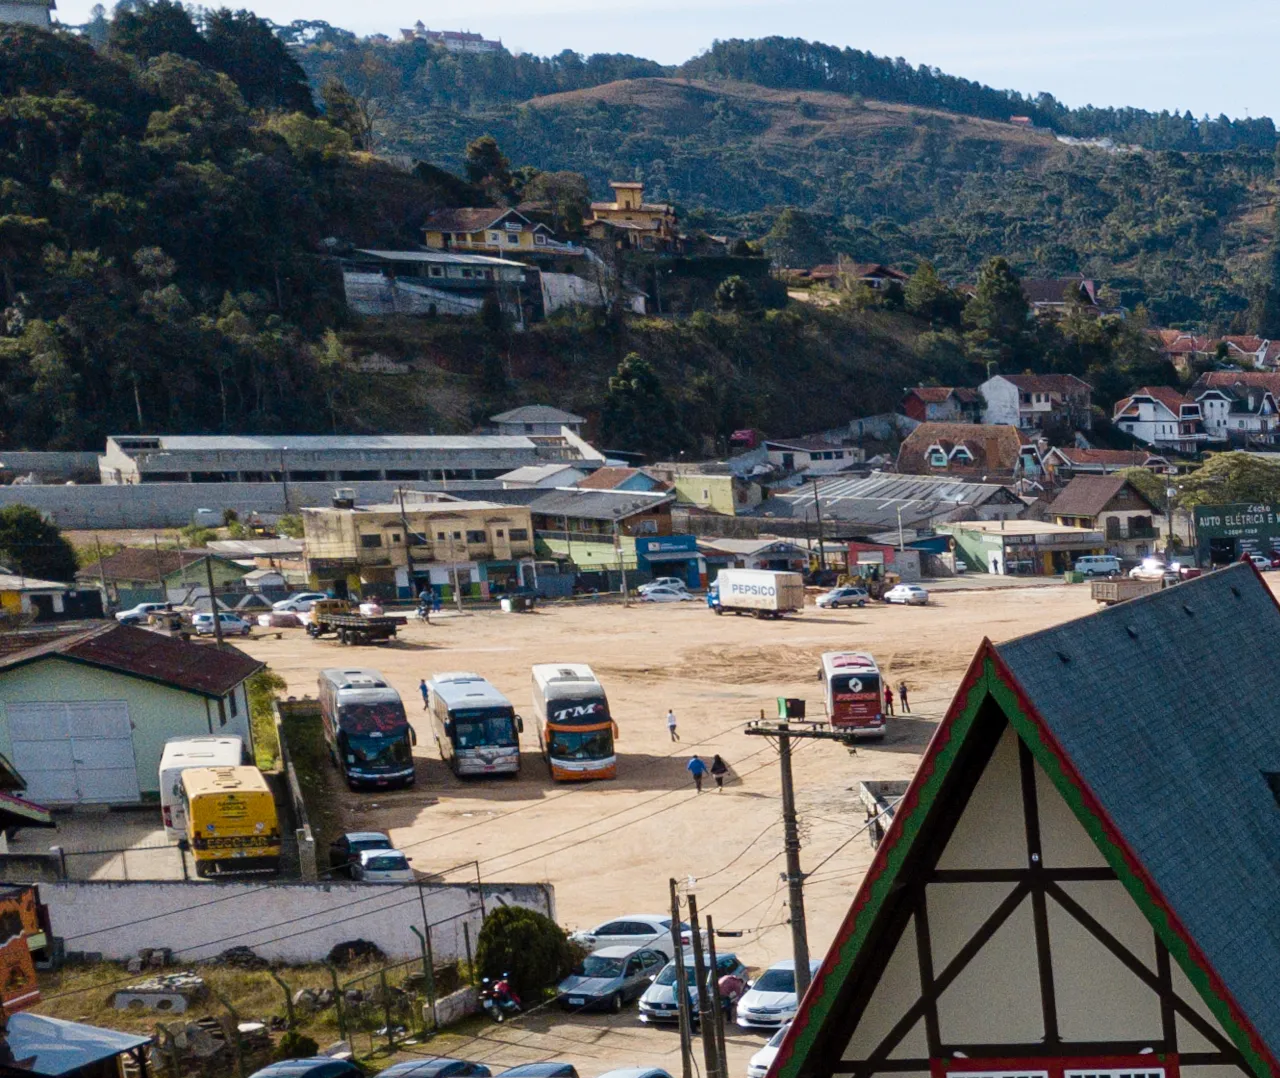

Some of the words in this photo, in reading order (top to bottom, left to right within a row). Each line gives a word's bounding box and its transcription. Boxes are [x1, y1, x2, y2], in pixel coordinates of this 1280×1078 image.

[1199, 516, 1220, 527] AUTO
[1225, 512, 1265, 526] ELÉTRICA
[1268, 514, 1274, 524] E
[731, 584, 776, 597] PEPSICO
[554, 703, 597, 721] TM
[207, 836, 269, 849] ESCOLAR
